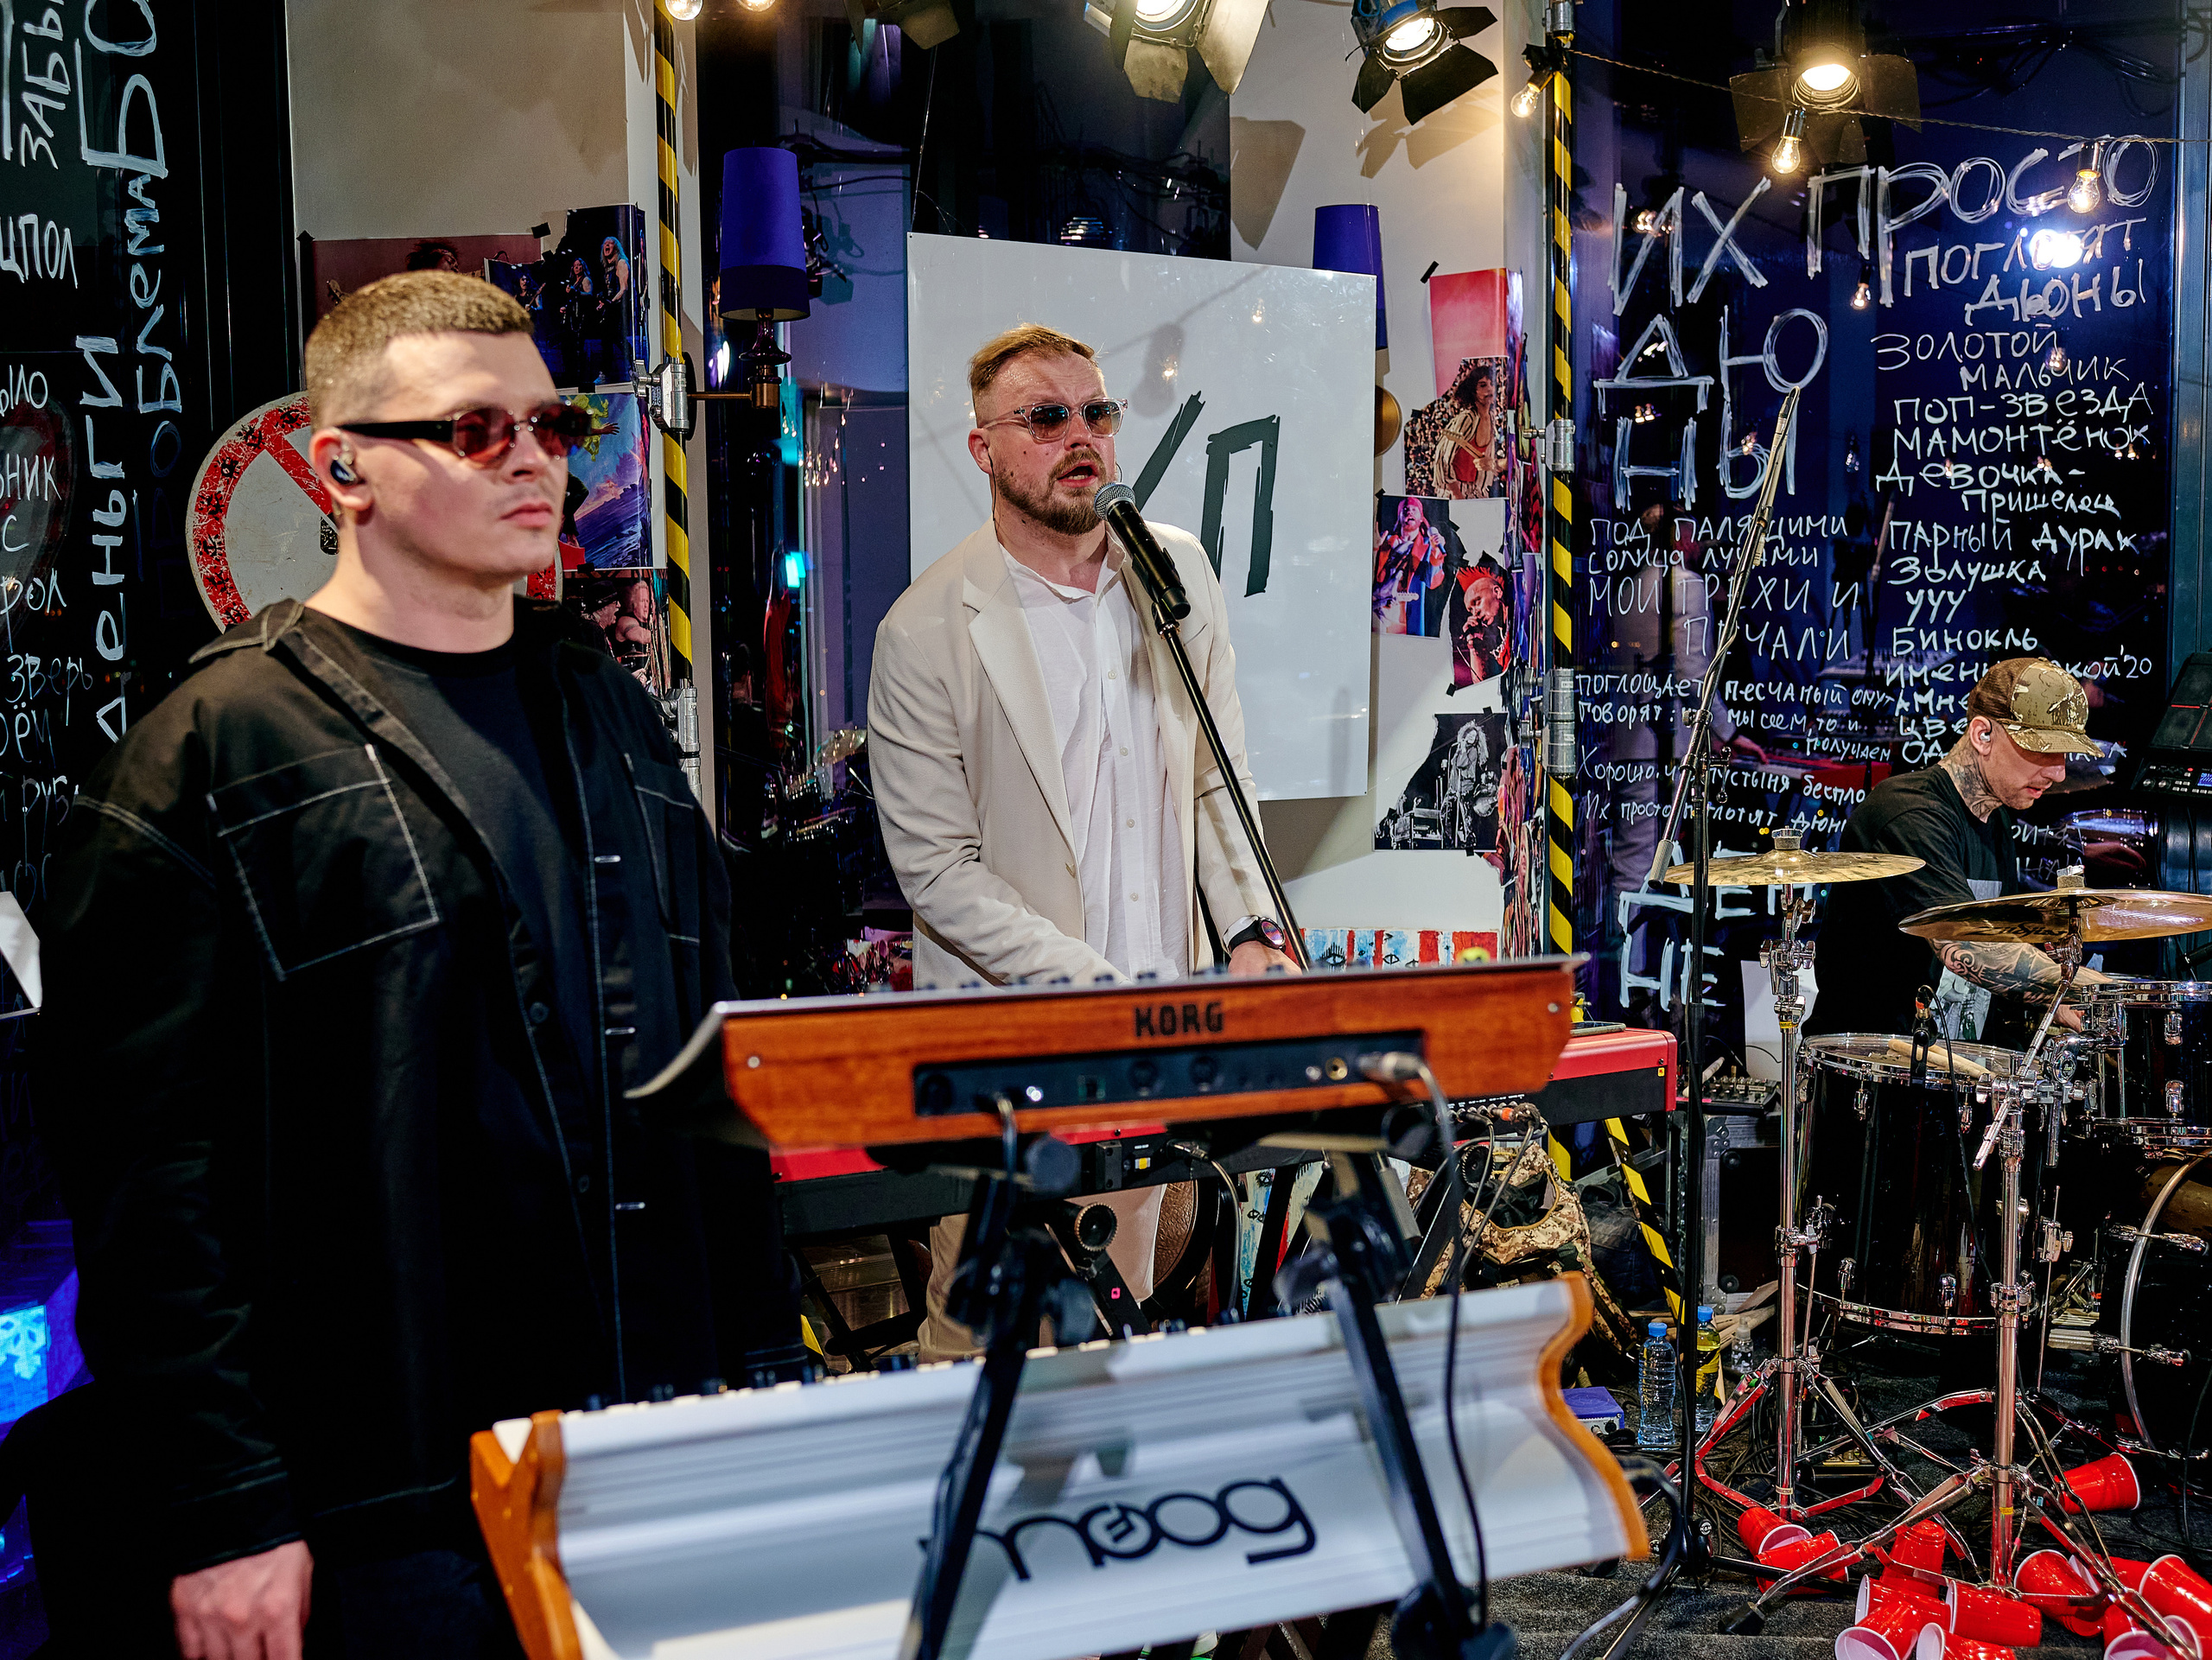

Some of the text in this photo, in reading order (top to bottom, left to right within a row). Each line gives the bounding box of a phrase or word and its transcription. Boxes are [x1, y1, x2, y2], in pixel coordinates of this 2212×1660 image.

[1609, 176, 1769, 316] ИХ
[1904, 217, 2147, 297] ПОГЛОЯТ
[1964, 258, 2147, 327] ДЮНЫ
[1871, 322, 2059, 371] ЗОЛОТОЙ
[1959, 354, 2130, 391] МАЛЬЧИК
[0, 452, 62, 502] НИК
[1589, 518, 1651, 550] ПОД
[1589, 576, 1662, 617] МОИ
[1831, 580, 1860, 612] И
[1892, 626, 2039, 657] БИНОКЛЬ
[1135, 1001, 1224, 1037] KORG
[918, 1476, 1317, 1581] moog
